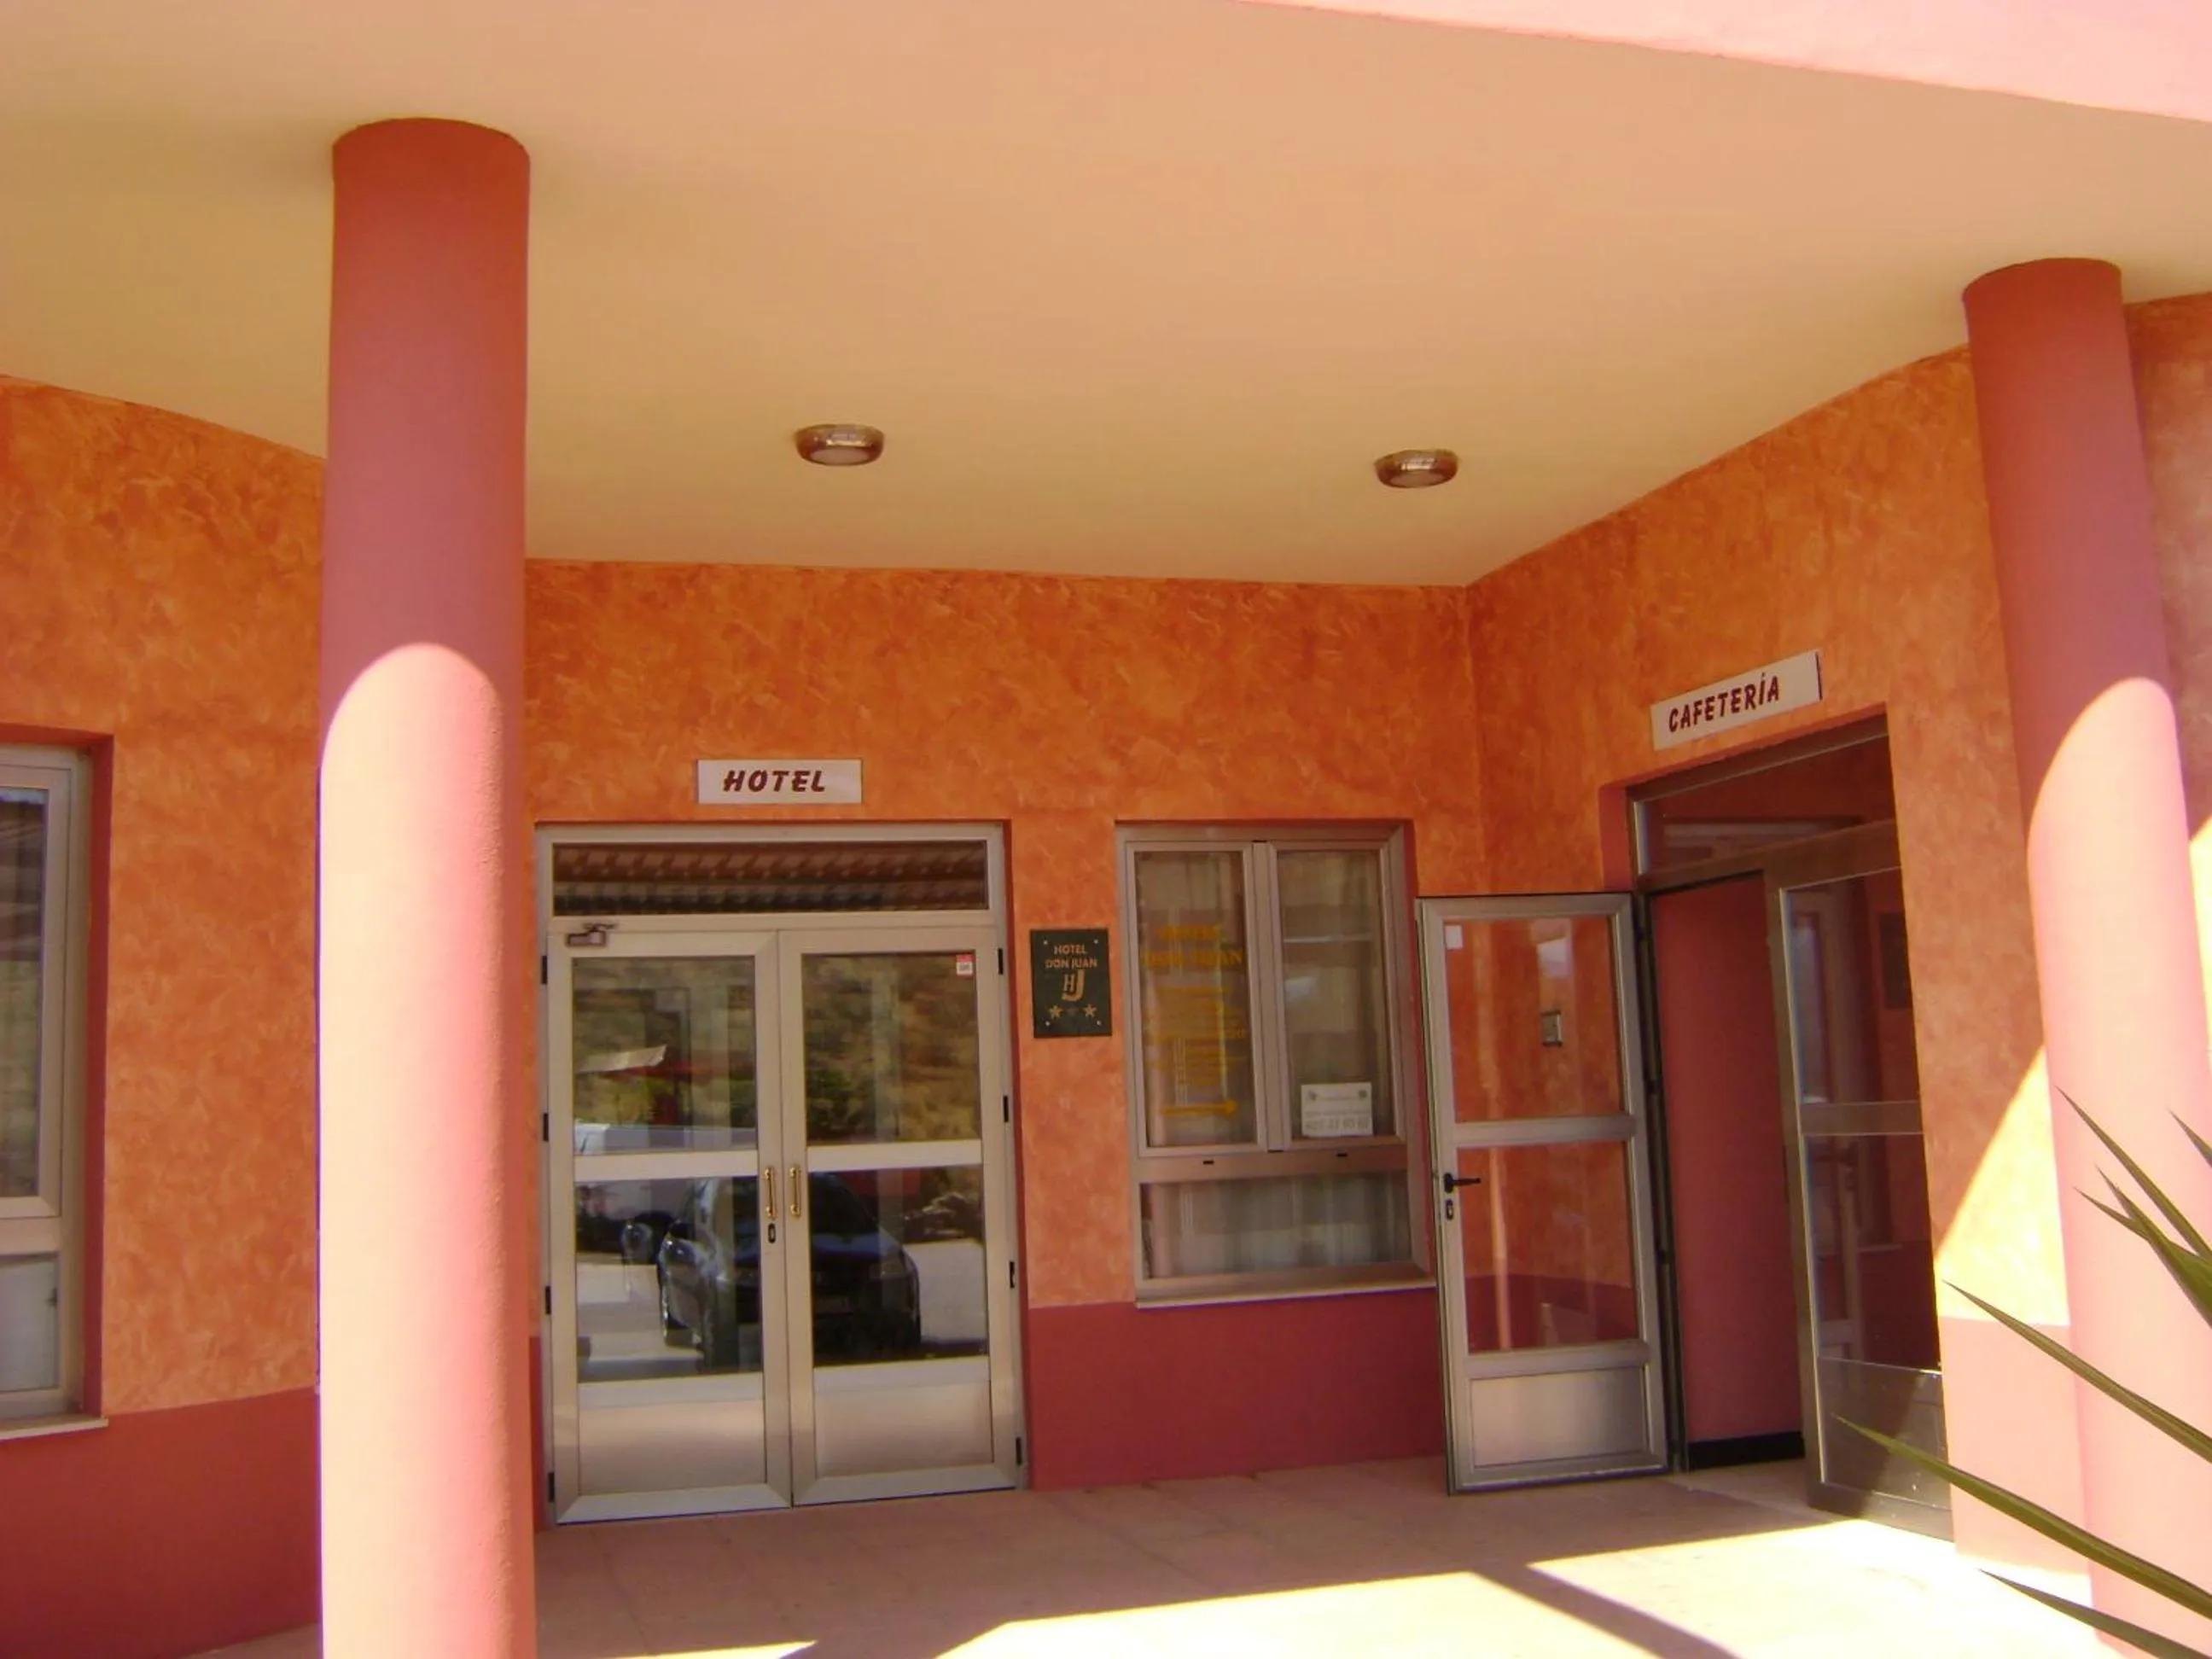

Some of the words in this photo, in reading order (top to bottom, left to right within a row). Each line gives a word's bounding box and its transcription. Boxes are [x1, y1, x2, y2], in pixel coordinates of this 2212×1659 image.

[1668, 672, 1779, 733] CAFETERÍA
[723, 769, 826, 793] HOTEL
[1053, 943, 1088, 955] HOTEL
[1045, 958, 1069, 969] DON
[1071, 957, 1098, 969] JUAN
